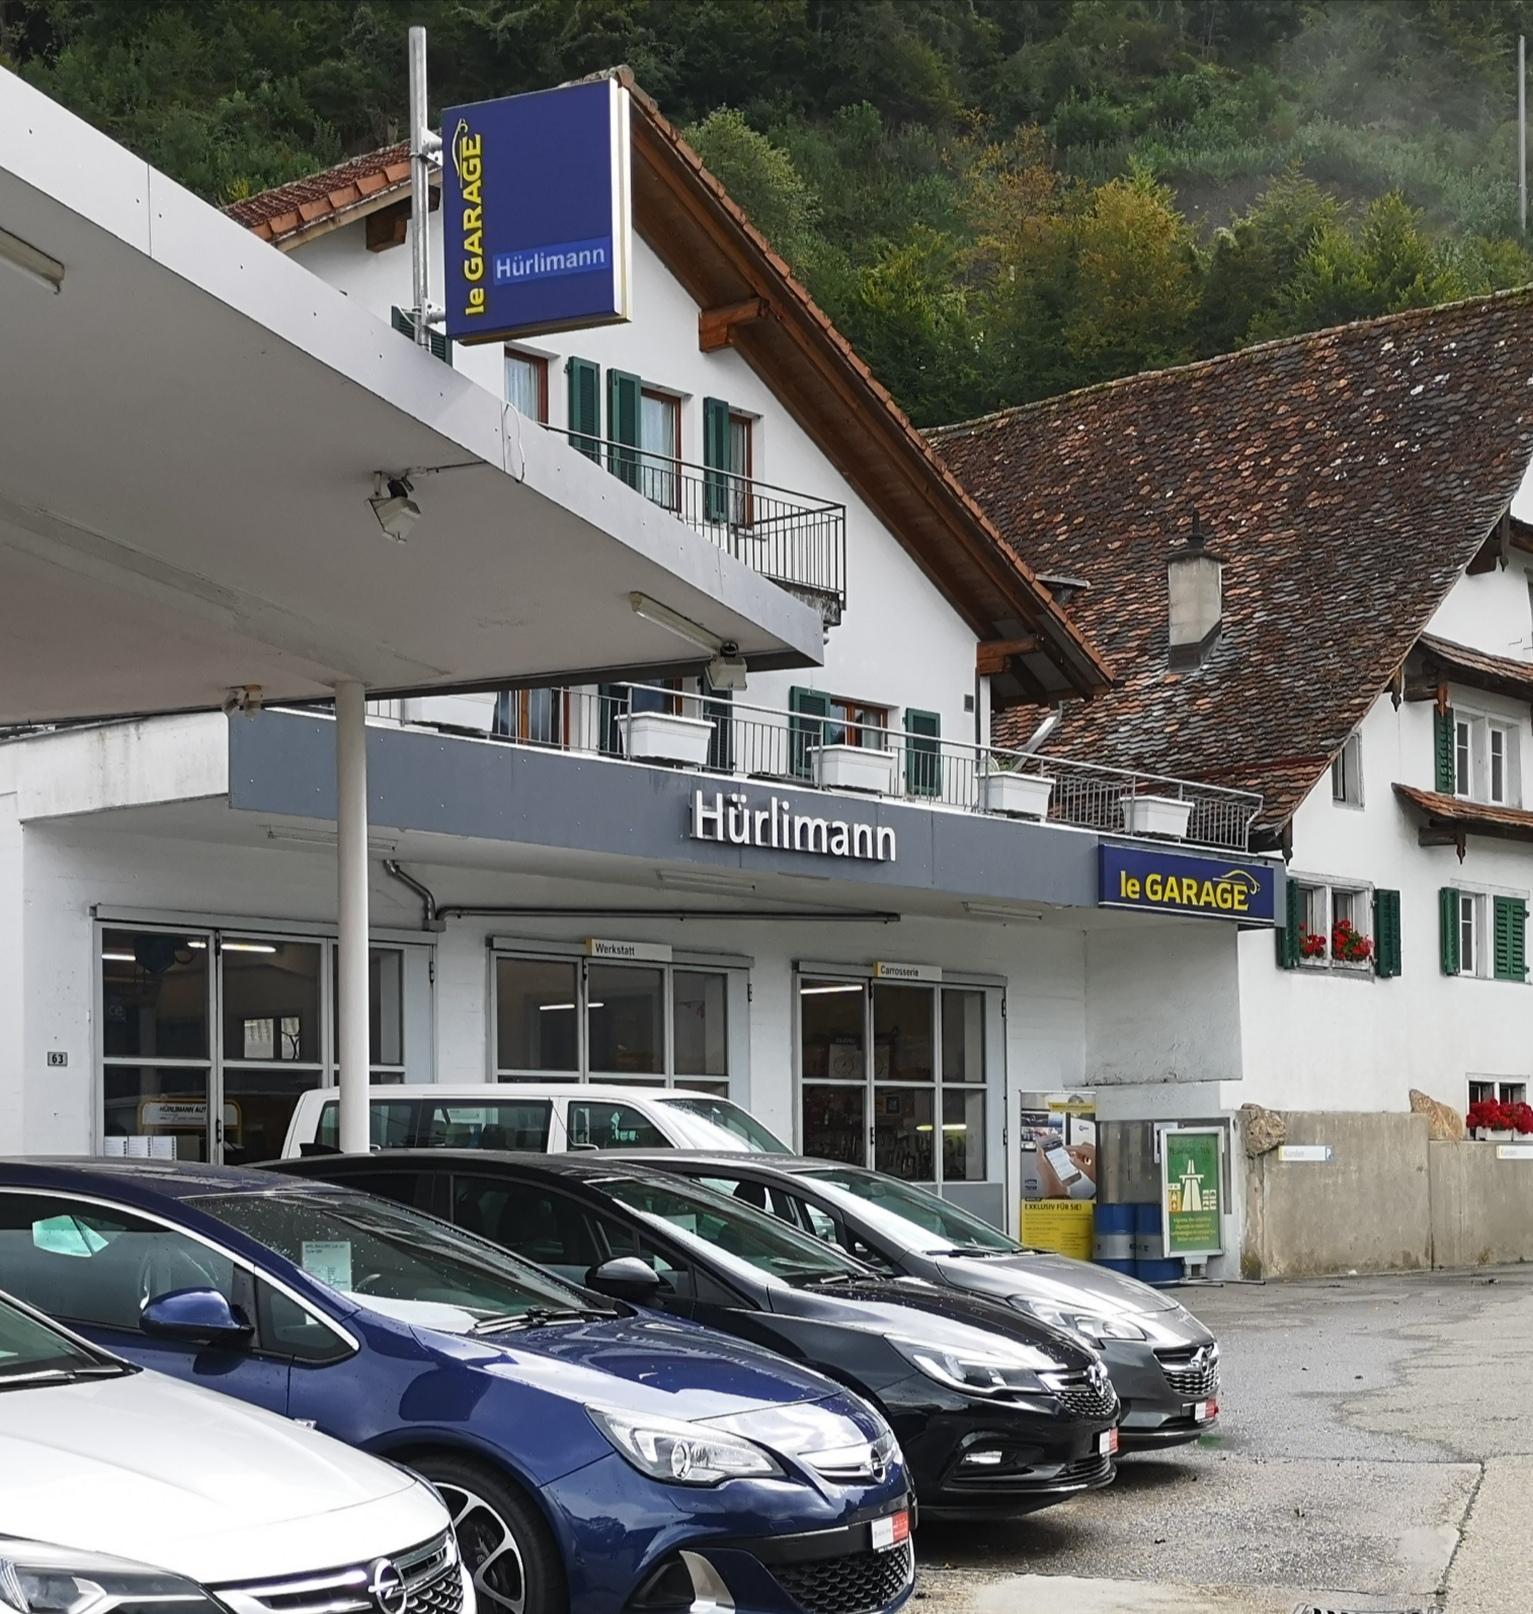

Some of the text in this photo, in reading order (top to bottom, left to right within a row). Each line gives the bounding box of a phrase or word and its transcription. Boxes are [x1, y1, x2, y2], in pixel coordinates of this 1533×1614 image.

[462, 133, 485, 316] le GARAGE
[496, 247, 605, 280] Hürlimann
[694, 789, 896, 862] Hürlimann
[1120, 870, 1249, 911] le GARAGE
[595, 943, 635, 956] Werkstatt
[880, 964, 919, 977] Carrosserie
[51, 1053, 64, 1064] 63
[1056, 1202, 1069, 1210] FÜR
